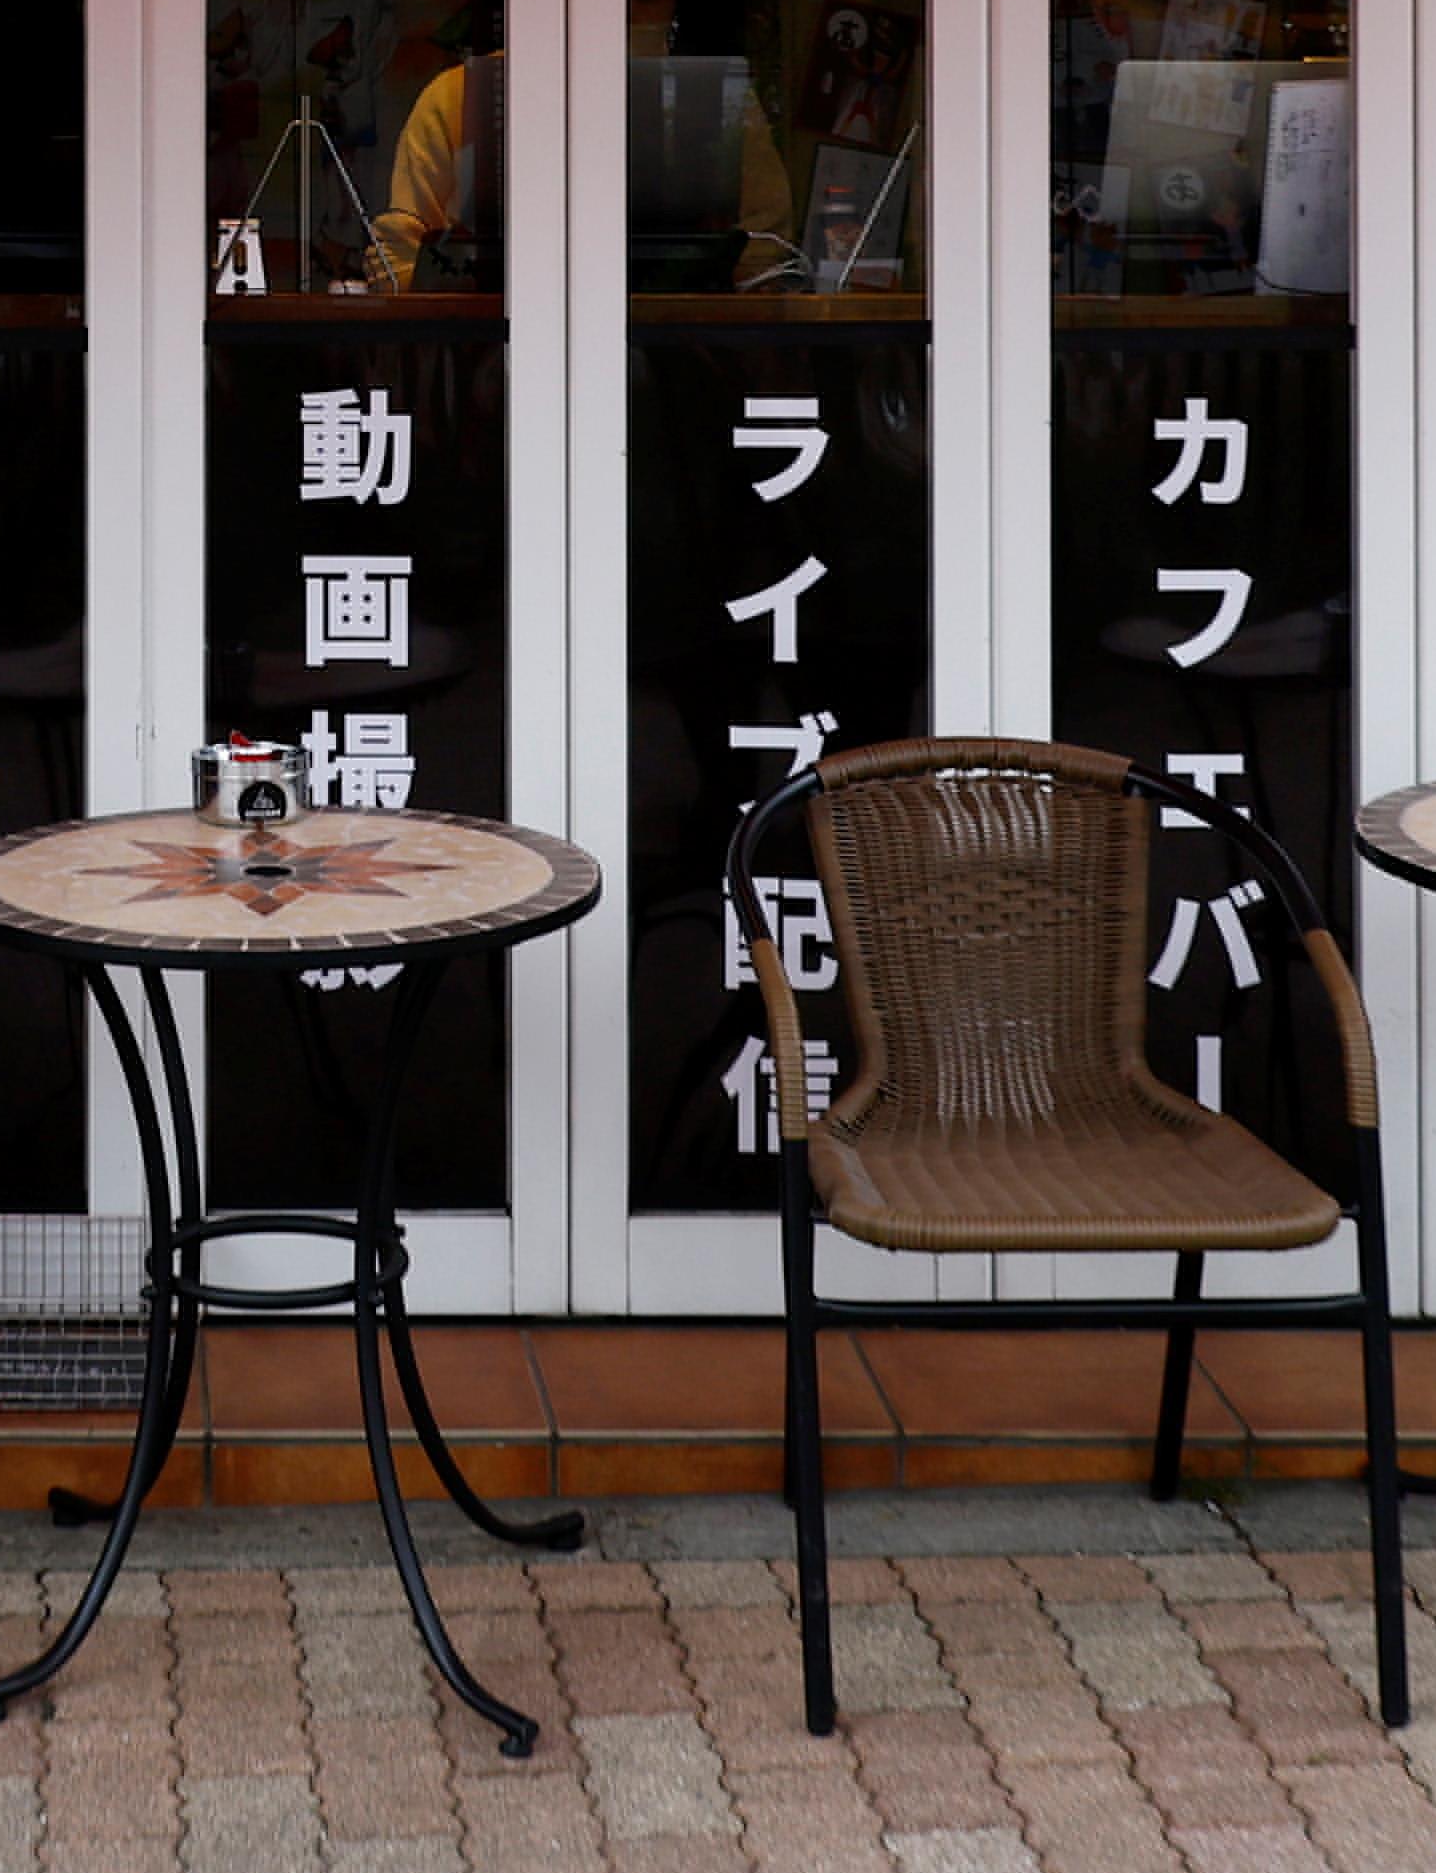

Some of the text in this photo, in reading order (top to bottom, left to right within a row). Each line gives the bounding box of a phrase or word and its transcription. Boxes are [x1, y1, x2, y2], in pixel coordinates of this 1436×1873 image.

[299, 388, 415, 991] 動画撮
[722, 396, 840, 1154] ライブ配信
[1147, 396, 1263, 1114] カフェバー
